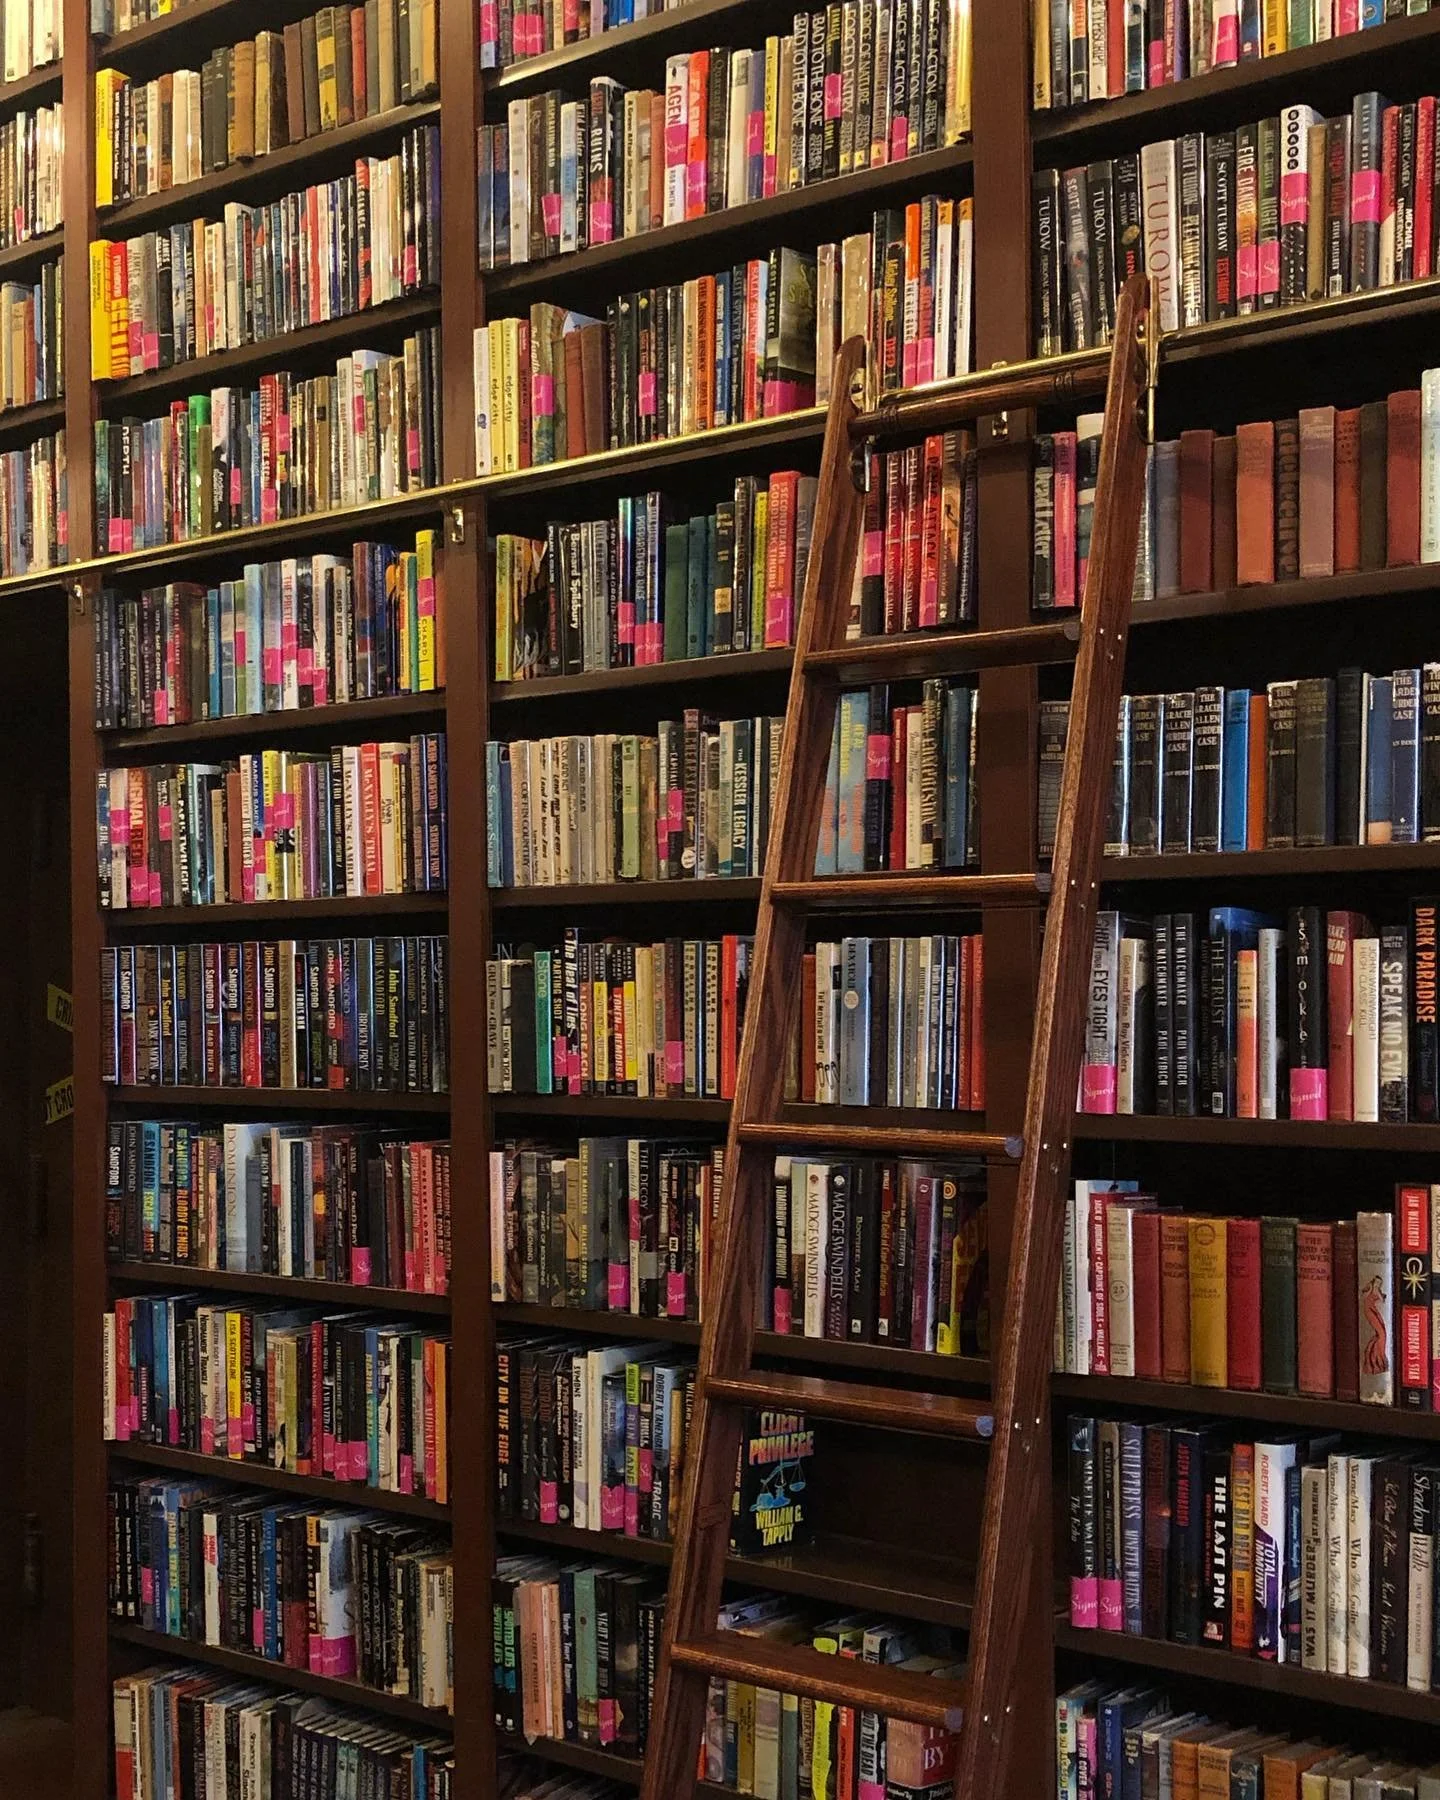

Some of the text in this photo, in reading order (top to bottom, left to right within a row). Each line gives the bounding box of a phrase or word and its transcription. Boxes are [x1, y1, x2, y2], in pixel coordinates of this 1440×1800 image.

[812, 17, 824, 41] BAD
[812, 43, 824, 60] TO
[792, 17, 806, 127] BAD TO THE BONE
[811, 61, 823, 88] THE
[811, 92, 822, 126] BONE
[590, 128, 603, 172] RUINS
[1183, 140, 1197, 167] SCOTT
[1238, 146, 1254, 172] FIRE
[1402, 114, 1410, 188] DEATH IN CAMERA
[1039, 197, 1051, 251] TUROW
[1094, 189, 1106, 242] TUROW
[1217, 163, 1228, 251] SCOTT TUROW
[122, 427, 130, 475] DEPTH
[569, 533, 580, 629] Bernard Spilsbury
[1200, 694, 1215, 702] THE
[1198, 737, 1217, 746] CASE
[130, 771, 143, 827] SIGNAL
[734, 763, 746, 806] KESSLER
[98, 772, 109, 846] THE GIRL
[363, 768, 376, 875] McNALLY'S TRIAL
[521, 782, 529, 867] COFFIN COUNTRY
[734, 810, 746, 849] LEGACY
[564, 939, 576, 958] The
[1095, 920, 1108, 951] SHUT
[1157, 927, 1166, 942] THE
[1177, 926, 1186, 941] THE
[1416, 908, 1435, 947] DARK
[120, 951, 131, 1010] JOHN SANDFORD
[229, 968, 238, 1009] SANDFORD
[264, 946, 276, 1008] JOHN SANDFORD
[537, 959, 549, 998] Stone
[553, 959, 562, 1020] PARTING SHOT
[565, 962, 577, 996] Heat
[1093, 970, 1108, 1001] EYES
[1122, 976, 1130, 992] and
[1157, 949, 1167, 1006] MATCHMAKER
[1177, 948, 1186, 1005] MATCHMAKER
[1211, 937, 1224, 1027] THE TRUST
[1382, 962, 1402, 1017] SPEAK
[1416, 951, 1436, 1023] PARADISE
[162, 979, 171, 1036] John Sandford
[328, 977, 336, 1030] SANDFORD
[389, 968, 399, 1038] John Sandford
[488, 965, 497, 1050] GREEN GRAVE
[1093, 1005, 1107, 1040] TIGHT
[358, 1013, 369, 1071] BROKEN PREY
[613, 994, 623, 1078] TOKEN REMORSE
[1120, 1041, 1129, 1072] Vickers
[1158, 1030, 1167, 1050] PAUL
[1177, 1030, 1186, 1049] PAUL
[1383, 1022, 1403, 1045] NO
[226, 1127, 237, 1217] DOMINION
[505, 1160, 514, 1202] PRESSURE
[640, 1148, 649, 1209] THE DECOY
[807, 1192, 820, 1299] MADGE SWINDELLS
[830, 1192, 845, 1299] MADGE SWINDELLS
[1095, 1262, 1103, 1291] CAPTAINS
[1096, 1292, 1103, 1302] OF
[1096, 1329, 1104, 1357] WALLACE
[498, 1355, 509, 1464] CITY ON THE EDGE
[1123, 1438, 1140, 1519] SCULPTRESS
[1261, 1454, 1269, 1526] ROBERT WARD
[1084, 1460, 1093, 1578] MINETTE WALTERS
[1214, 1476, 1226, 1608] THE LAST PIN
[1412, 1472, 1430, 1572] Shadow Walk
[1255, 1539, 1265, 1608] IMMUNITY
[1265, 1543, 1275, 1578] TOTAL
[1329, 1535, 1341, 1566] Who
[1351, 1538, 1361, 1569] Who
[861, 1731, 874, 1776] THE DEAD
[924, 1745, 940, 1769] BY
